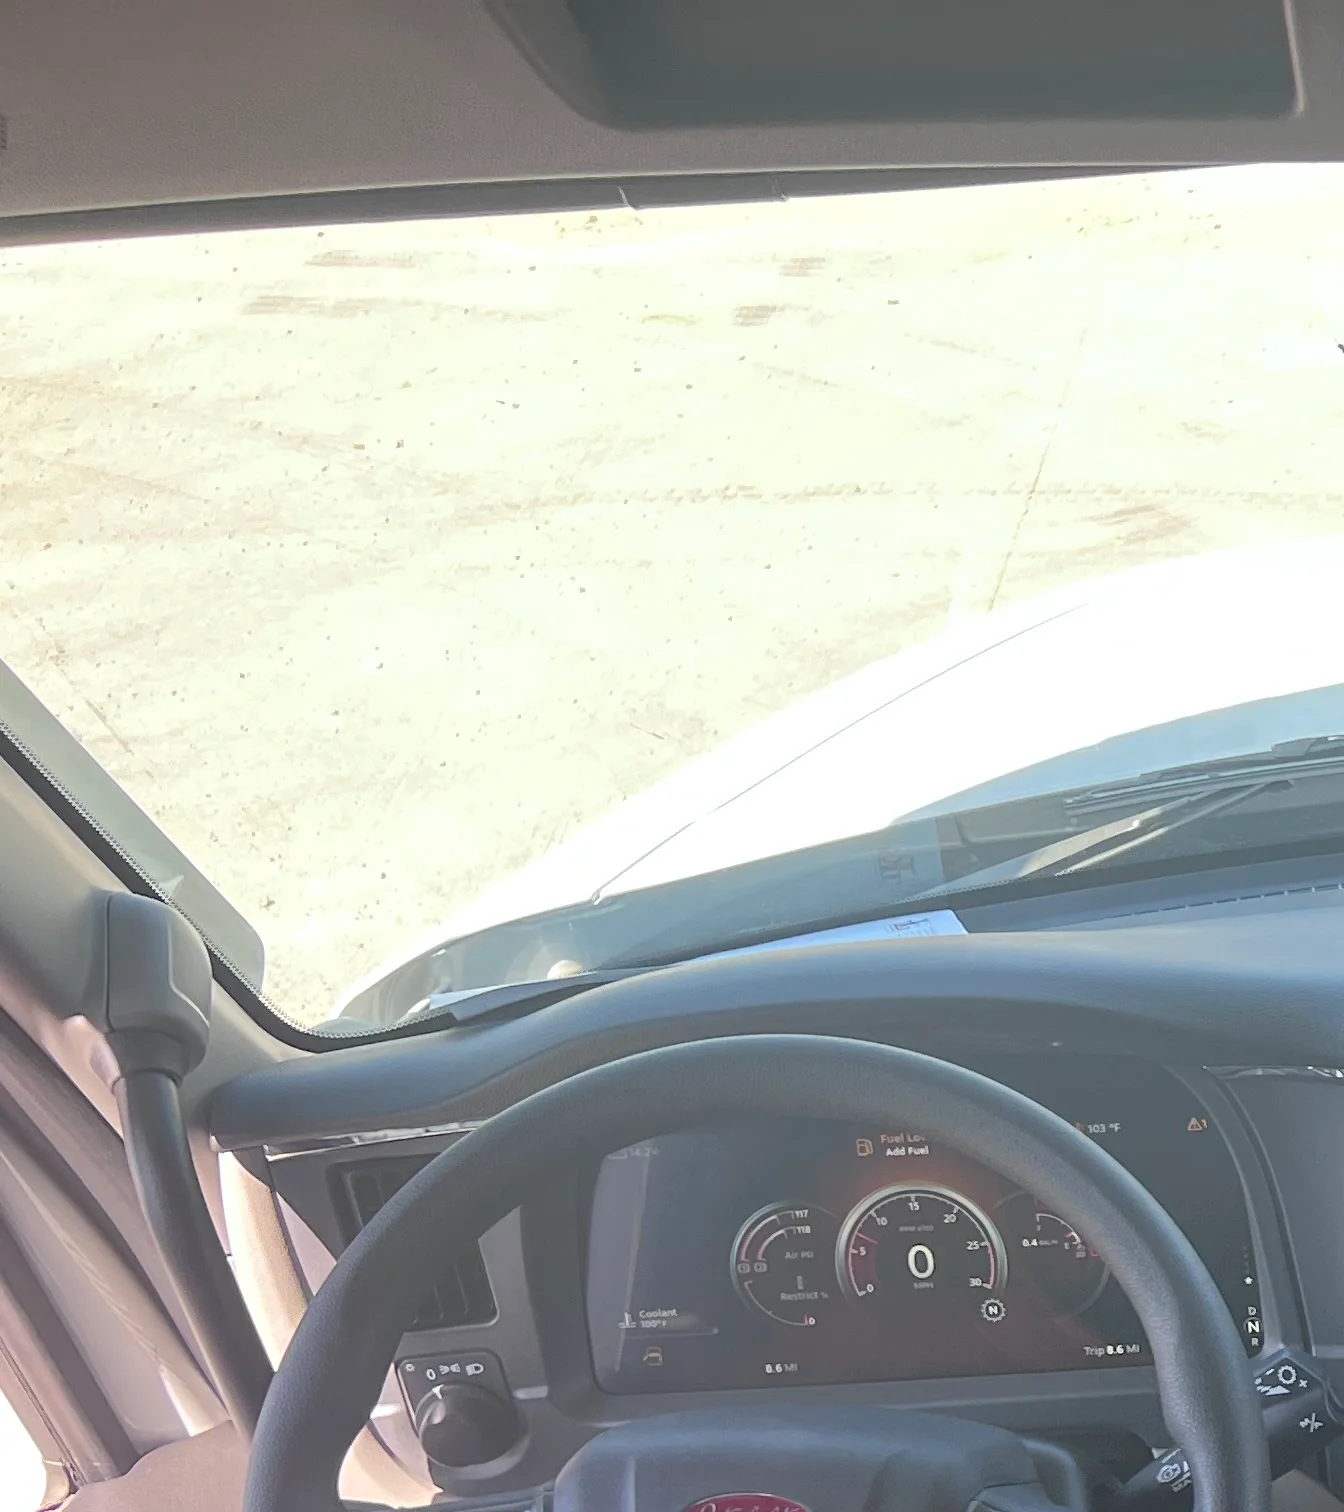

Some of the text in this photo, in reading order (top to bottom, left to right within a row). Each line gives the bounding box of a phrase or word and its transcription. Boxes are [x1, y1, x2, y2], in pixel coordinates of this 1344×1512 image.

[1088, 1123, 1106, 1134] 103
[880, 1134, 905, 1144] Fuel
[886, 1145, 930, 1157] Add Fuel
[908, 1201, 920, 1212] 15
[876, 1216, 888, 1227] 10
[943, 1213, 957, 1225] 20
[966, 1240, 980, 1251] 25
[1022, 1238, 1038, 1248] 0.4
[859, 1246, 867, 1256] 5
[907, 1243, 936, 1280] 0
[969, 1277, 983, 1287] 30
[866, 1283, 874, 1293] 0
[780, 1291, 819, 1302] Restrict
[639, 1308, 678, 1319] Coolant
[1248, 1306, 1257, 1317] D
[1247, 1320, 1260, 1334] N
[1251, 1337, 1260, 1347] R
[1083, 1346, 1105, 1358] Trip
[1106, 1344, 1124, 1355] 8.6
[765, 1363, 783, 1374] 8.6
